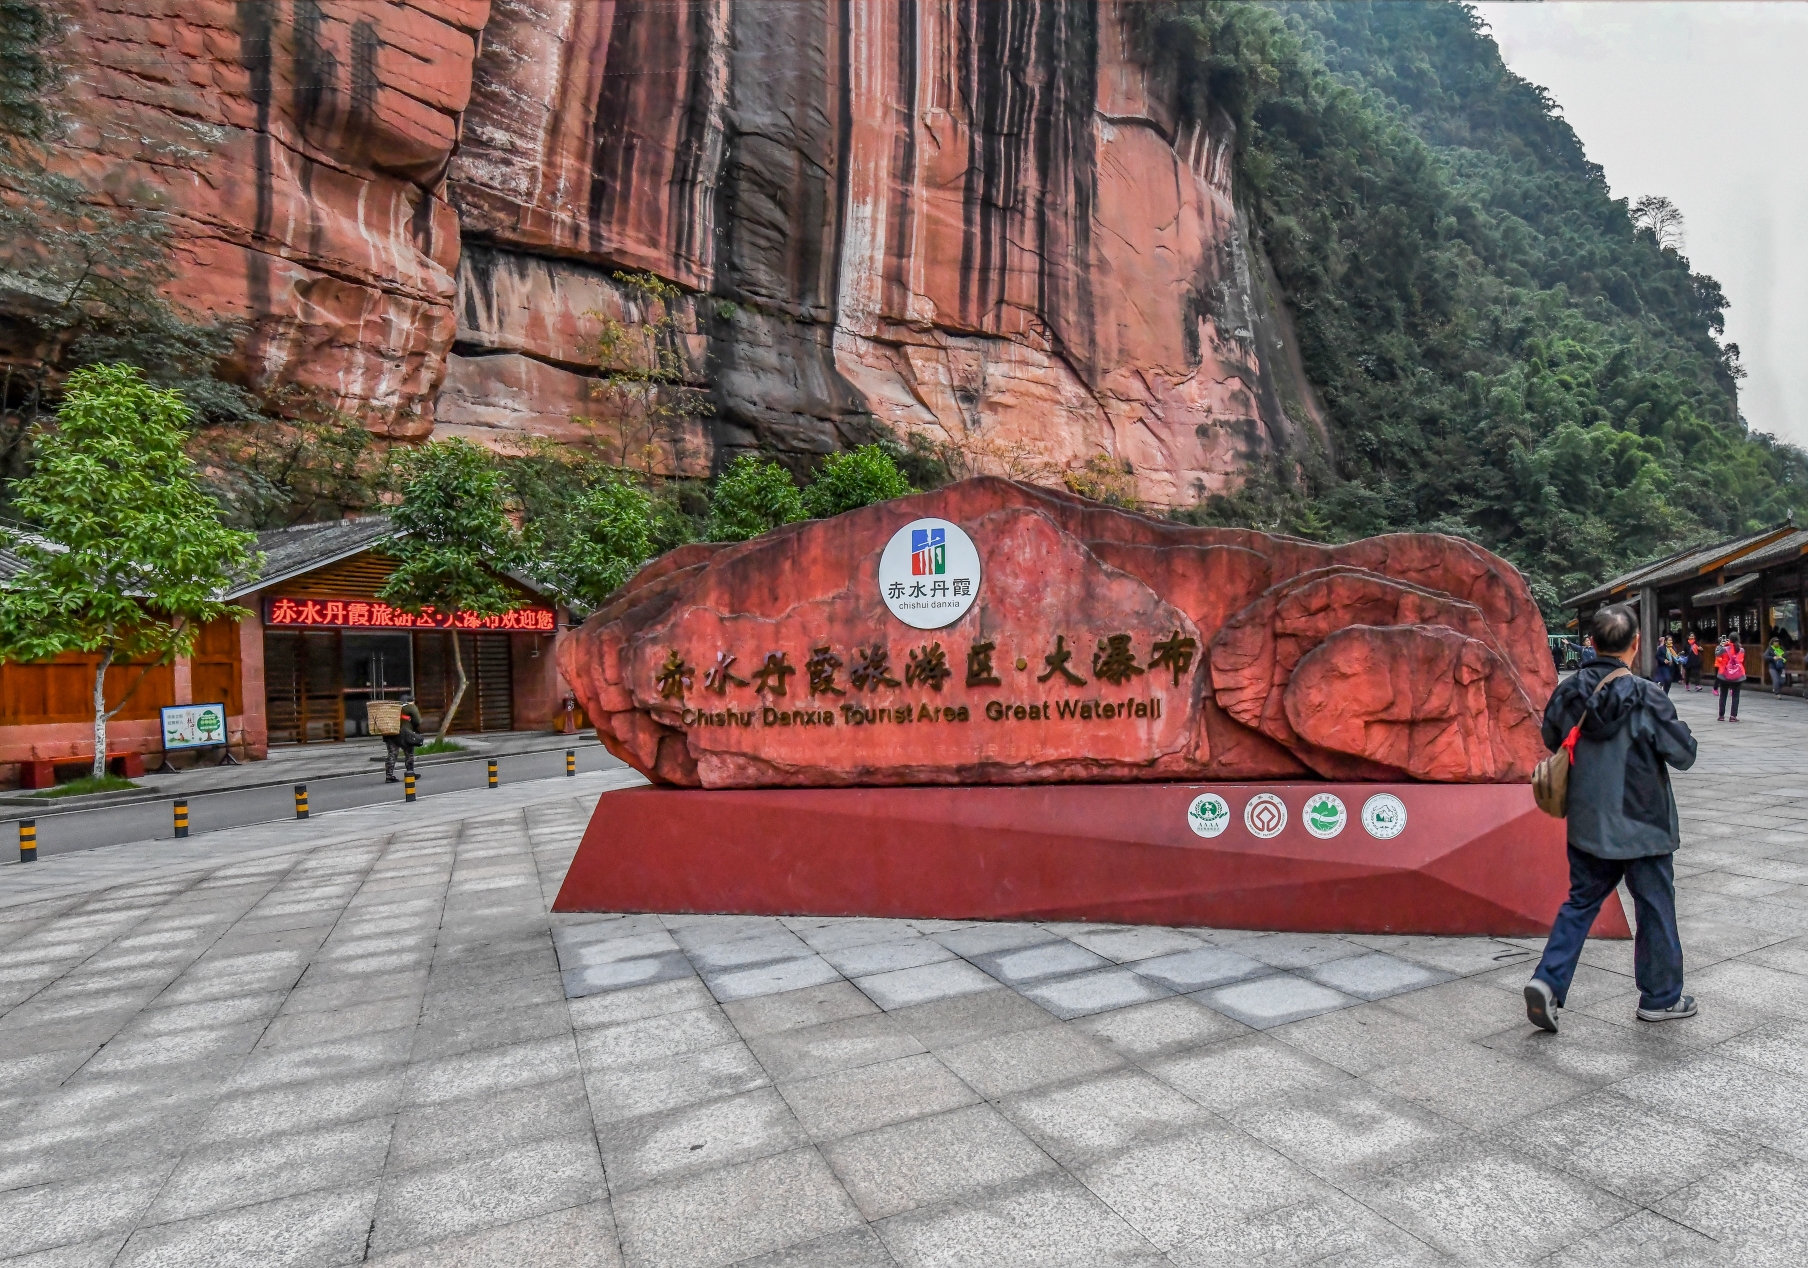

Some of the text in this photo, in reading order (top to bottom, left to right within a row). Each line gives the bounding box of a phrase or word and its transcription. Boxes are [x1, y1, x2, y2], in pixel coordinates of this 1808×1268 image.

[888, 578, 971, 599] 赤水丹霞
[899, 600, 960, 610] chishui danxia
[655, 629, 1197, 700] 赤水丹霞旅游区·大瀑布
[763, 706, 835, 726] Danxia
[840, 703, 913, 725] Tourist
[917, 702, 970, 723] Area
[986, 699, 1050, 722] Great
[1056, 696, 1162, 720] Waterfall
